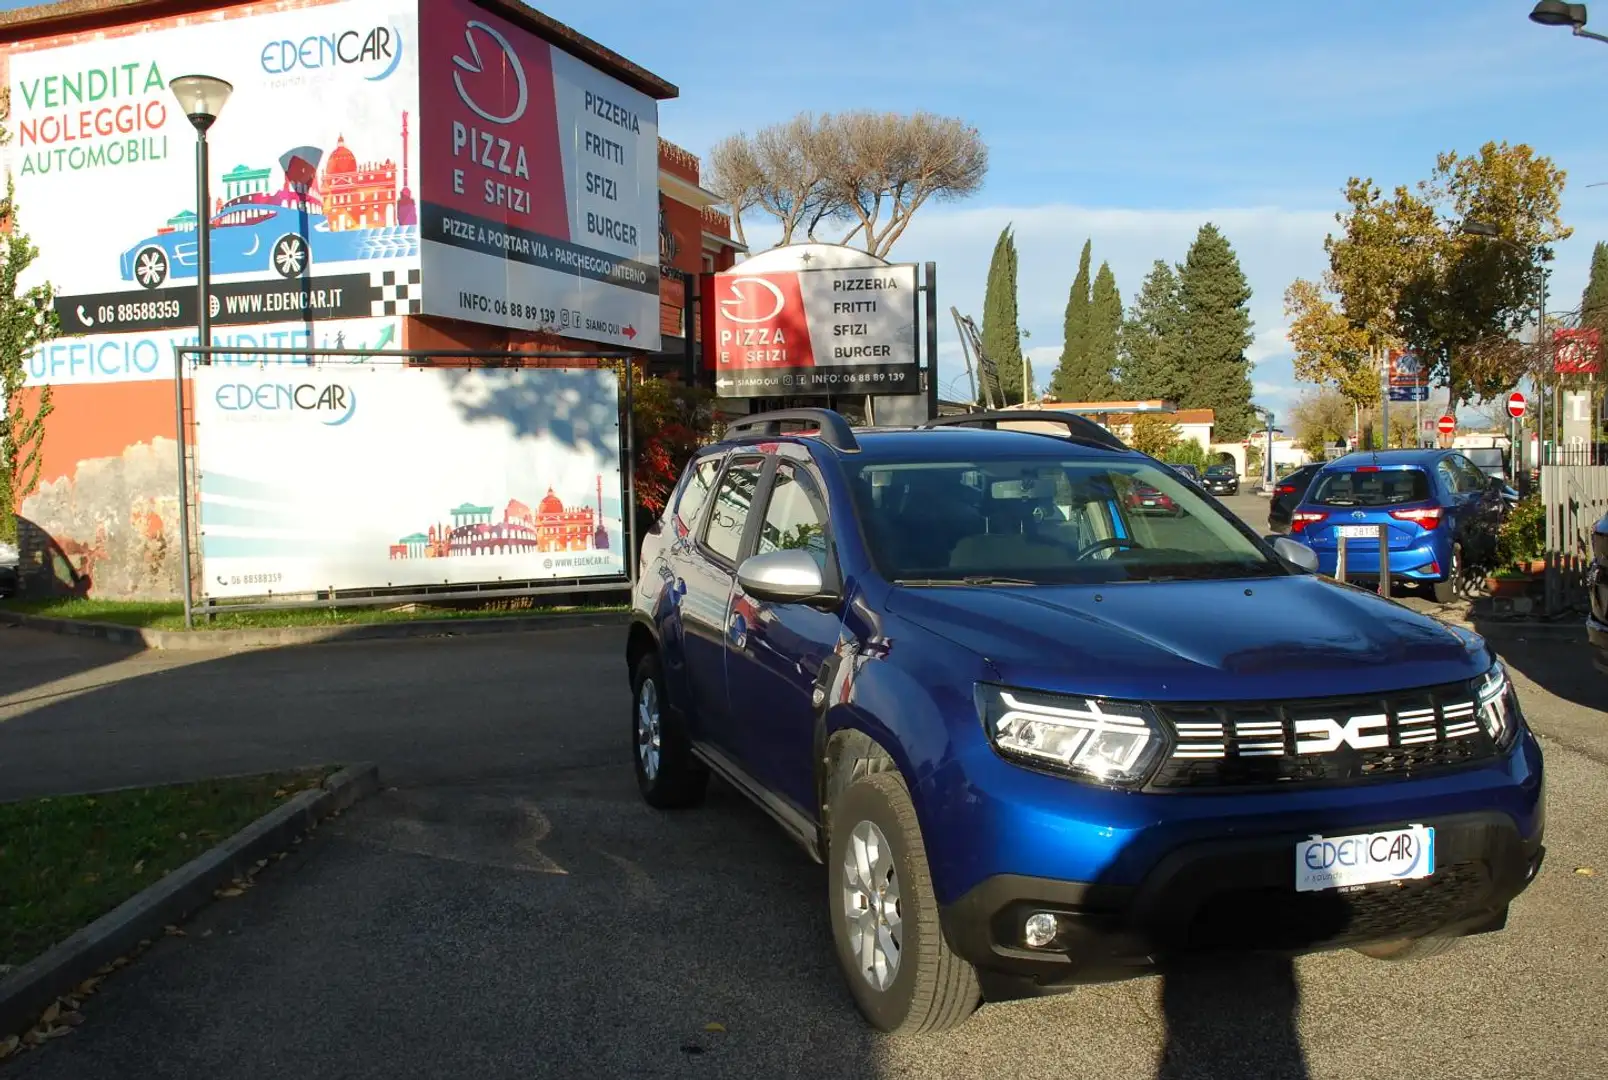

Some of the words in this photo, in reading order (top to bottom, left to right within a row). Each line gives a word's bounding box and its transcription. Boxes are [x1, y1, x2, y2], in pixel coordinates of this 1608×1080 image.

[261, 26, 392, 74] EDENCAR
[20, 60, 165, 110] VENDITA
[20, 100, 167, 147] NOLEGGIO
[584, 90, 641, 136] PIZZERIA
[20, 135, 168, 177] AUTOMOBILI
[453, 120, 530, 181] PIZZA
[585, 131, 624, 166] FRITTI
[453, 170, 465, 195] E
[484, 177, 532, 215] SFIZI
[586, 171, 618, 202] SFIZI
[587, 211, 638, 247] BURGER
[443, 217, 476, 241] PIZZE
[488, 230, 530, 256] PORTAR
[531, 240, 549, 260] VIA
[555, 247, 611, 276] PARCHEGGIO
[612, 263, 647, 285] INTERNO
[833, 278, 898, 292] PIZZERIA
[98, 305, 115, 324] 06
[117, 300, 180, 322] 88588359
[226, 288, 343, 315] WWW.EDENCAR.IT
[459, 291, 492, 313] INFO:
[494, 299, 508, 316] 06
[510, 303, 523, 318] 88
[525, 305, 537, 320] 89
[540, 307, 556, 324] 139
[833, 301, 877, 314] FRITTI
[585, 318, 607, 332] SIAMO
[608, 323, 620, 336] QUI
[720, 328, 786, 347] PIZZA
[833, 324, 868, 337] SFIZI
[29, 338, 160, 379] UFFICIO
[720, 351, 730, 364] E
[746, 349, 787, 364] SFIZI
[834, 345, 891, 358] BURGER
[737, 378, 763, 387] SIAMO
[764, 378, 779, 387] QUI
[812, 374, 841, 384] INFO:
[843, 374, 855, 383] 06
[858, 373, 870, 382] 88
[873, 373, 885, 382] 89
[888, 373, 905, 382] 139
[215, 383, 347, 411] EDENCAR
[555, 555, 610, 568] WWW.EDENCAR.IT
[231, 575, 242, 585] 06
[1305, 833, 1413, 870] EDENCAR
